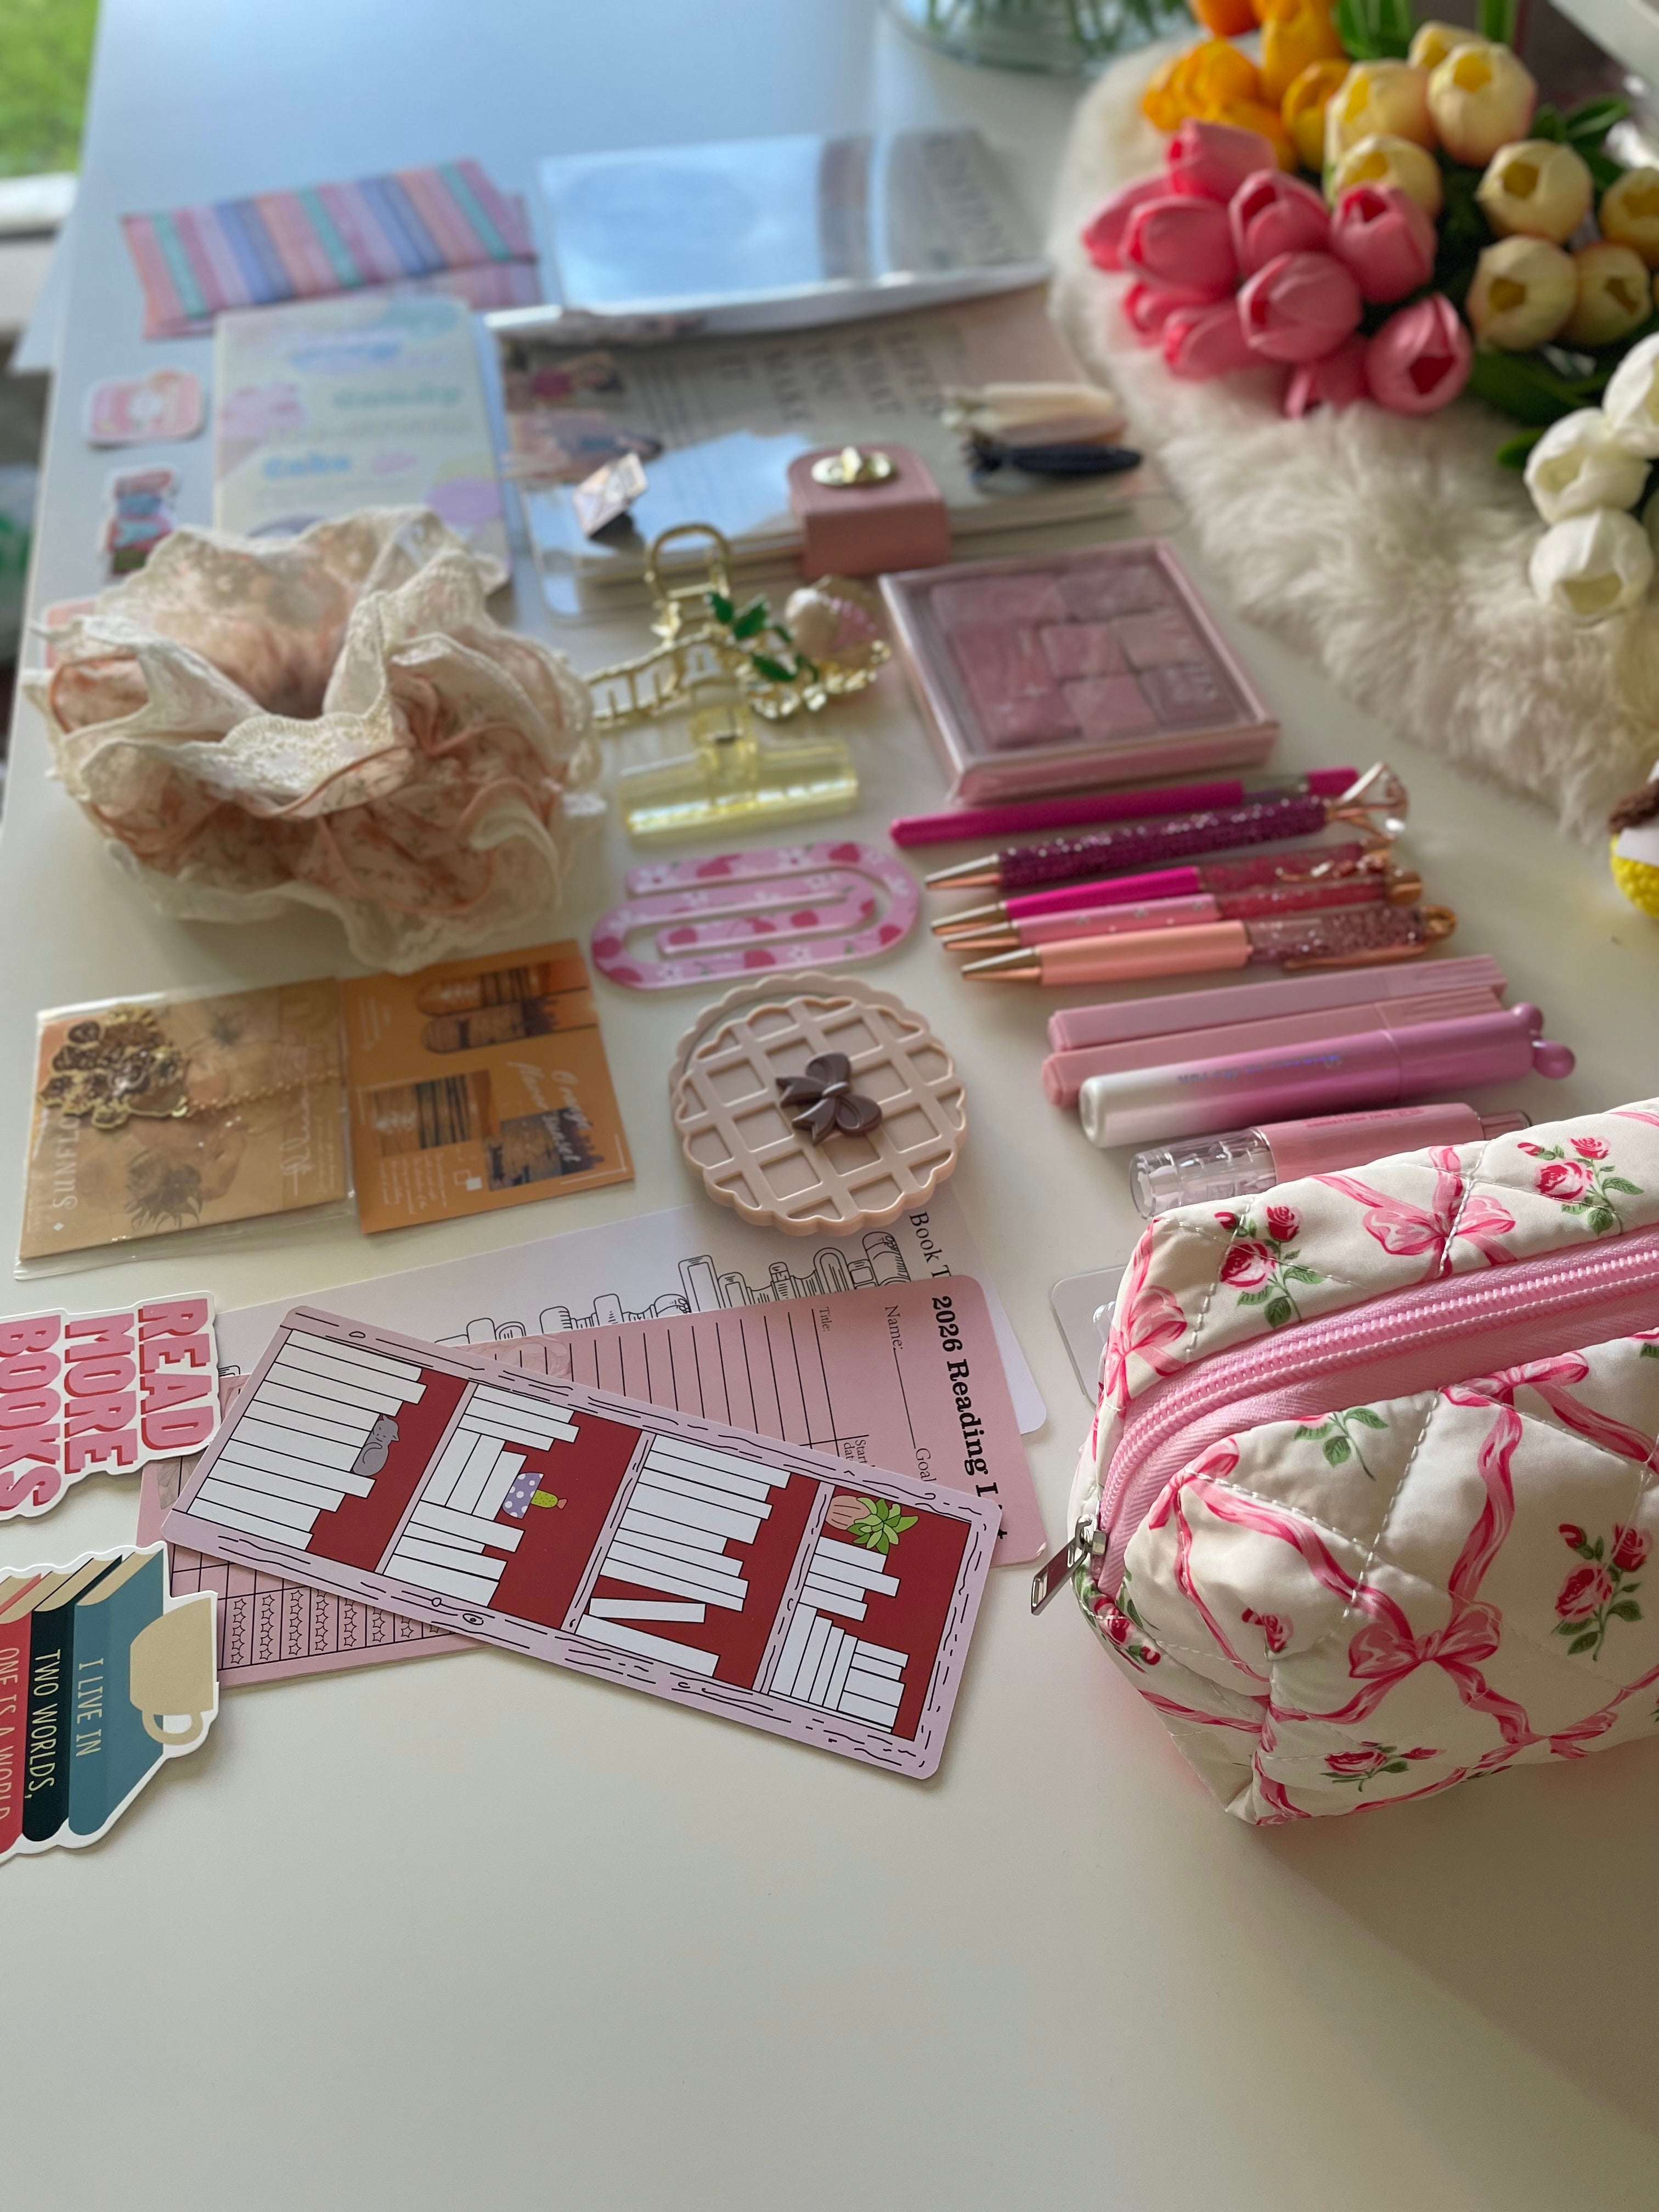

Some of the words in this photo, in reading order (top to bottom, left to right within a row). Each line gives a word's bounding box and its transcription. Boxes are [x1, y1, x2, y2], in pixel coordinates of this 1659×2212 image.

[53, 1115, 81, 1210] SUNFLO
[909, 1210, 943, 1263] Book
[930, 1265, 952, 1279] T
[819, 1306, 832, 1332] Title:
[932, 1295, 963, 1352] 2026
[64, 1313, 138, 1475] MORE
[138, 1299, 215, 1450] READ
[884, 1305, 904, 1351] Name:
[915, 1447, 937, 1482] Goal
[0, 1315, 61, 1512] BOOKS
[946, 1358, 989, 1476] Reading
[843, 1442, 856, 1462] dat
[0, 1647, 20, 1685] ONE
[33, 1649, 61, 1696] TWO
[78, 1658, 104, 1671] I
[77, 1676, 104, 1724] LIVE
[25, 1703, 58, 1799] WORLDS,
[76, 1729, 102, 1757] IN
